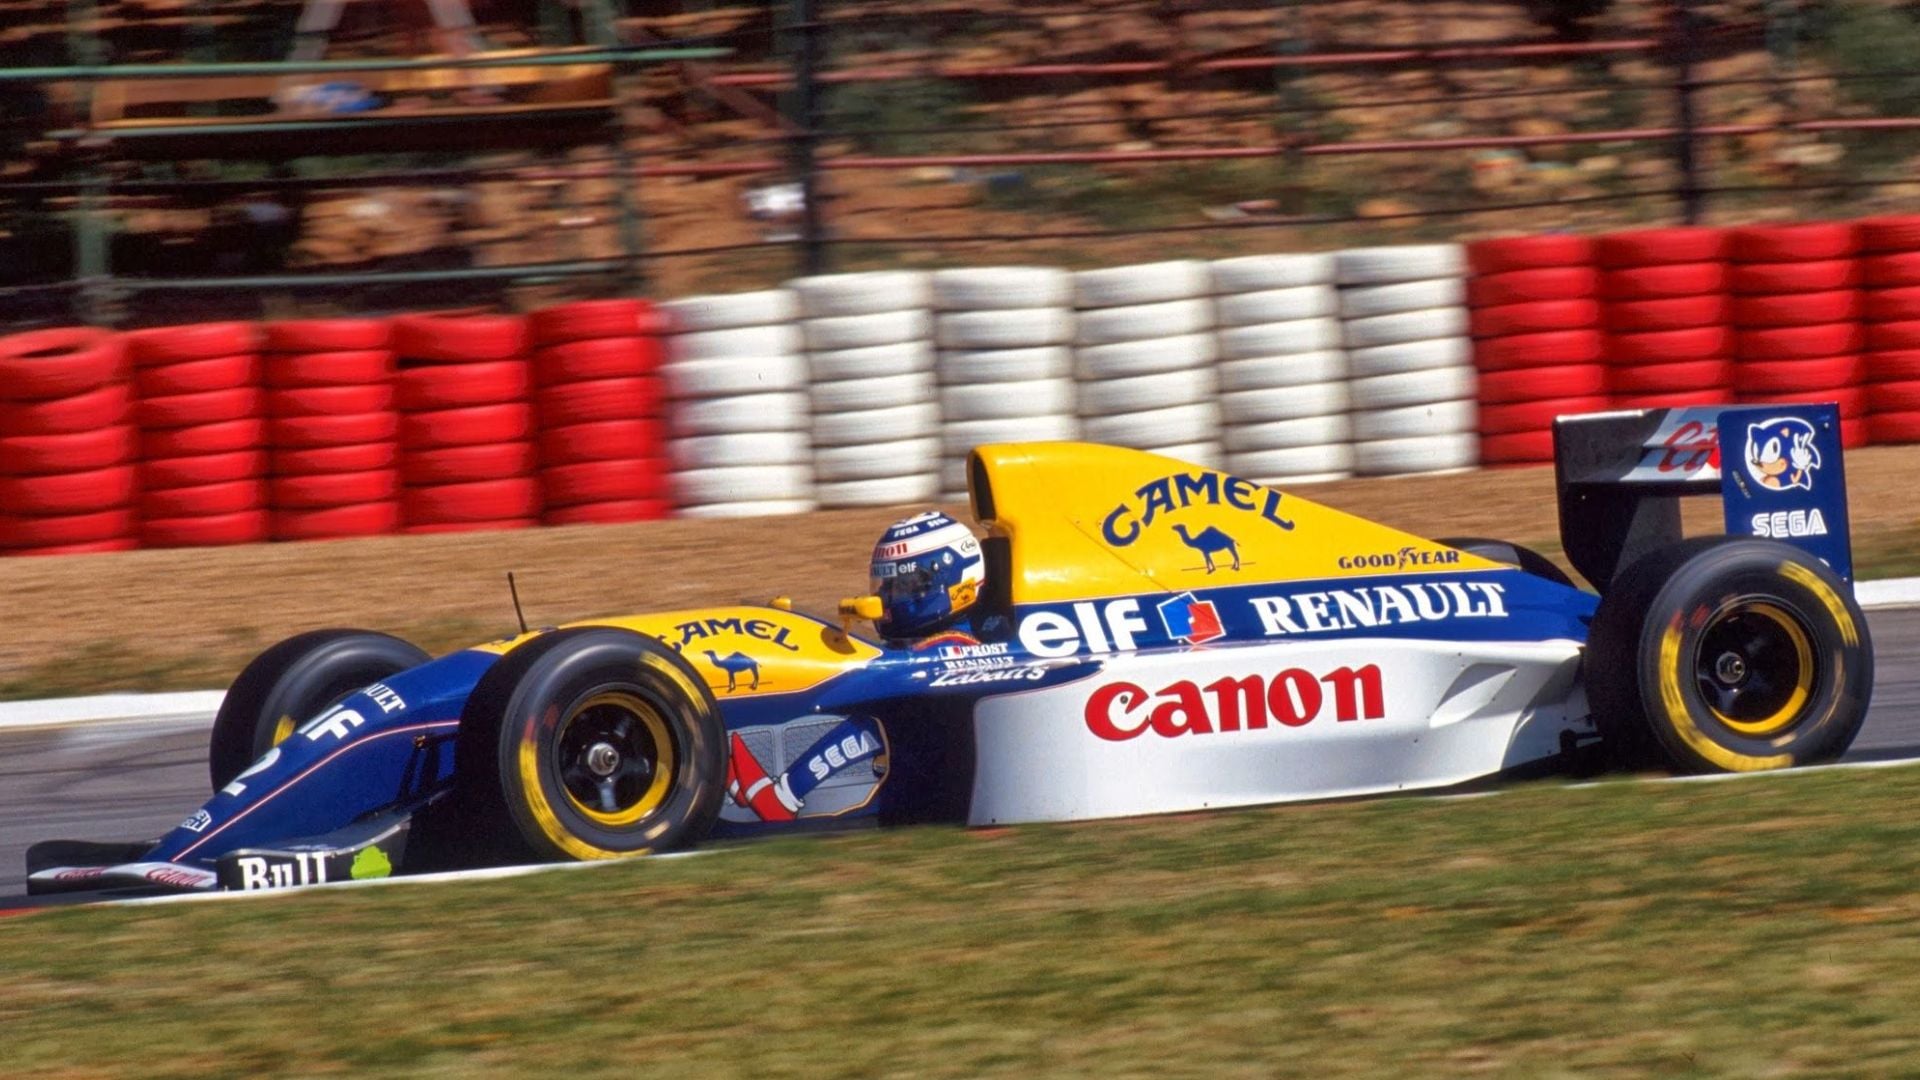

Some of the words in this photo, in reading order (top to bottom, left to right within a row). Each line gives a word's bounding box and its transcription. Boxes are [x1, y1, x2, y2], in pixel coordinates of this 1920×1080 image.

[1102, 472, 1295, 546] CAMEL
[1752, 508, 1828, 538] SEGA
[898, 561, 917, 574] elf
[1018, 598, 1147, 657] elf
[1249, 582, 1509, 637] RENAULT
[943, 656, 1015, 670] RENAULT
[960, 643, 1009, 657] PROST
[809, 730, 881, 782] SEGA
[237, 851, 332, 891] Bull
